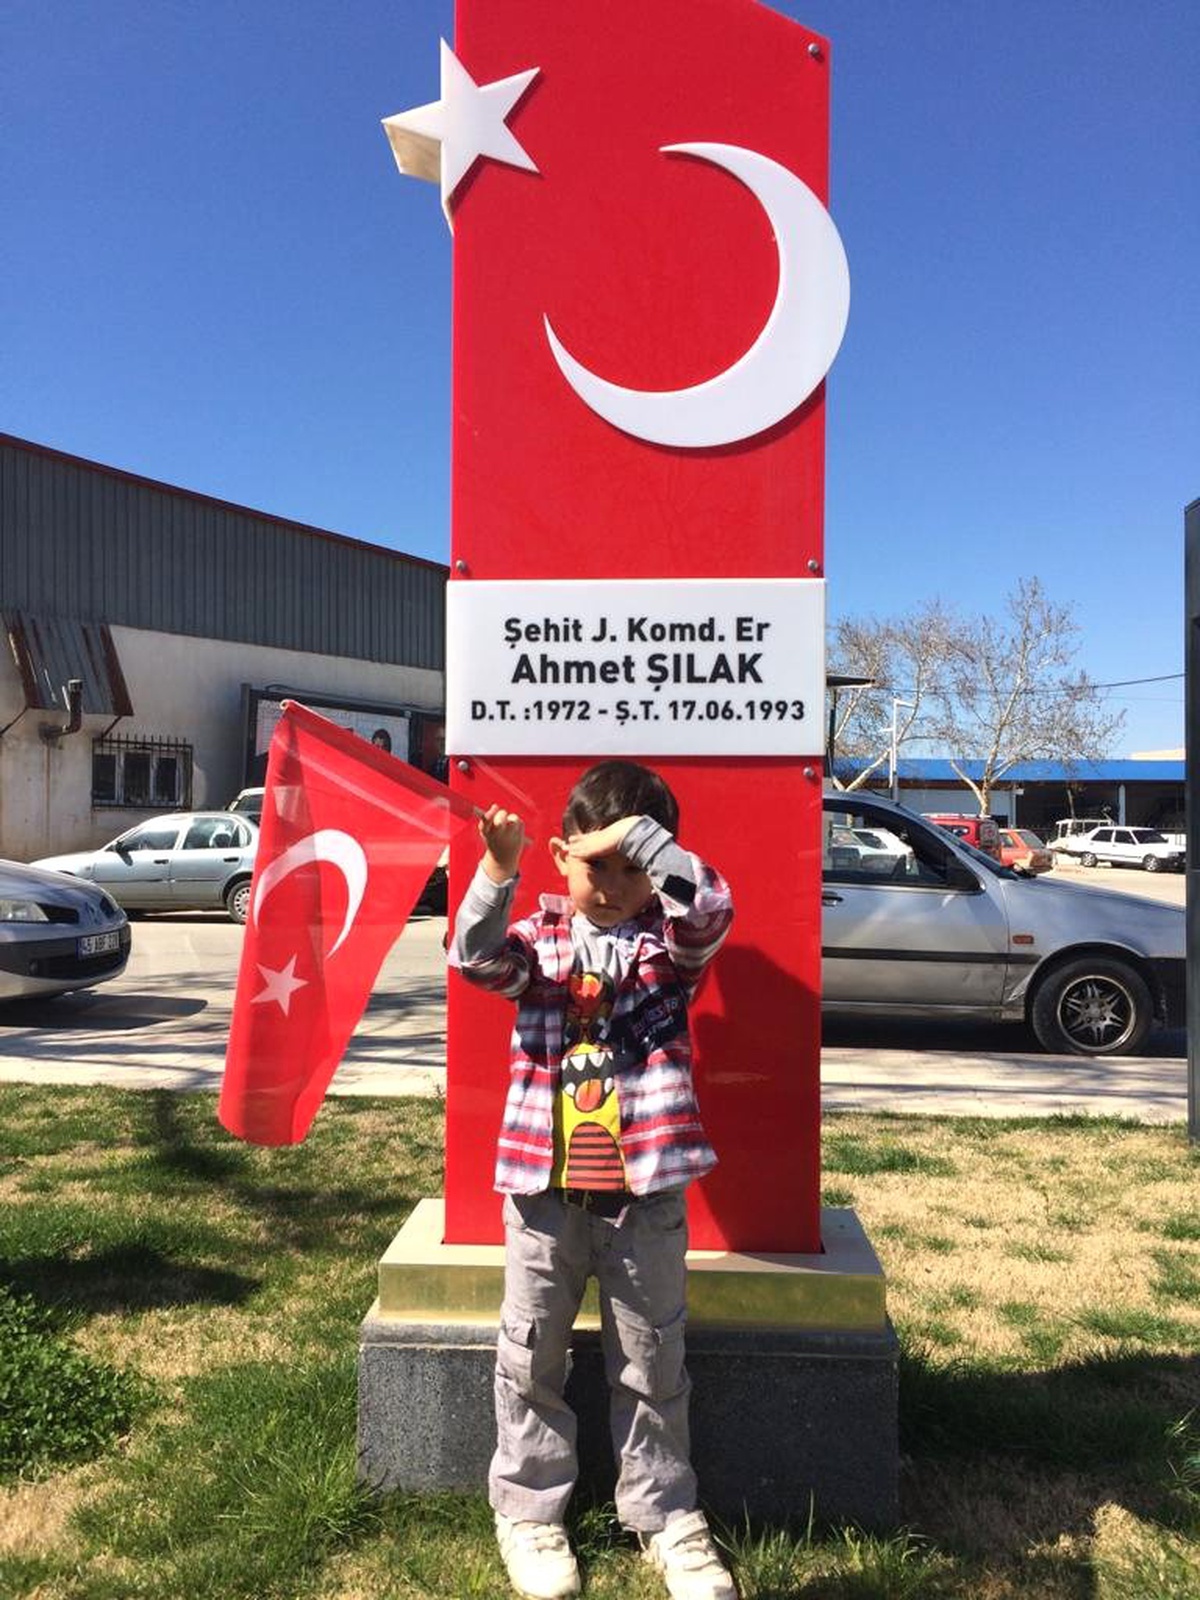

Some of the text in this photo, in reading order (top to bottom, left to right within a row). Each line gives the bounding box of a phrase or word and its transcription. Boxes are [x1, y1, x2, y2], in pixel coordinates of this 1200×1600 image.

[504, 616, 771, 649] Şehit J. Komd. Er
[511, 652, 763, 692] Ahmet ŞILAK
[471, 700, 516, 721] D.T.
[615, 700, 660, 726] Ş.T.
[668, 699, 805, 721] 17.06.1993
